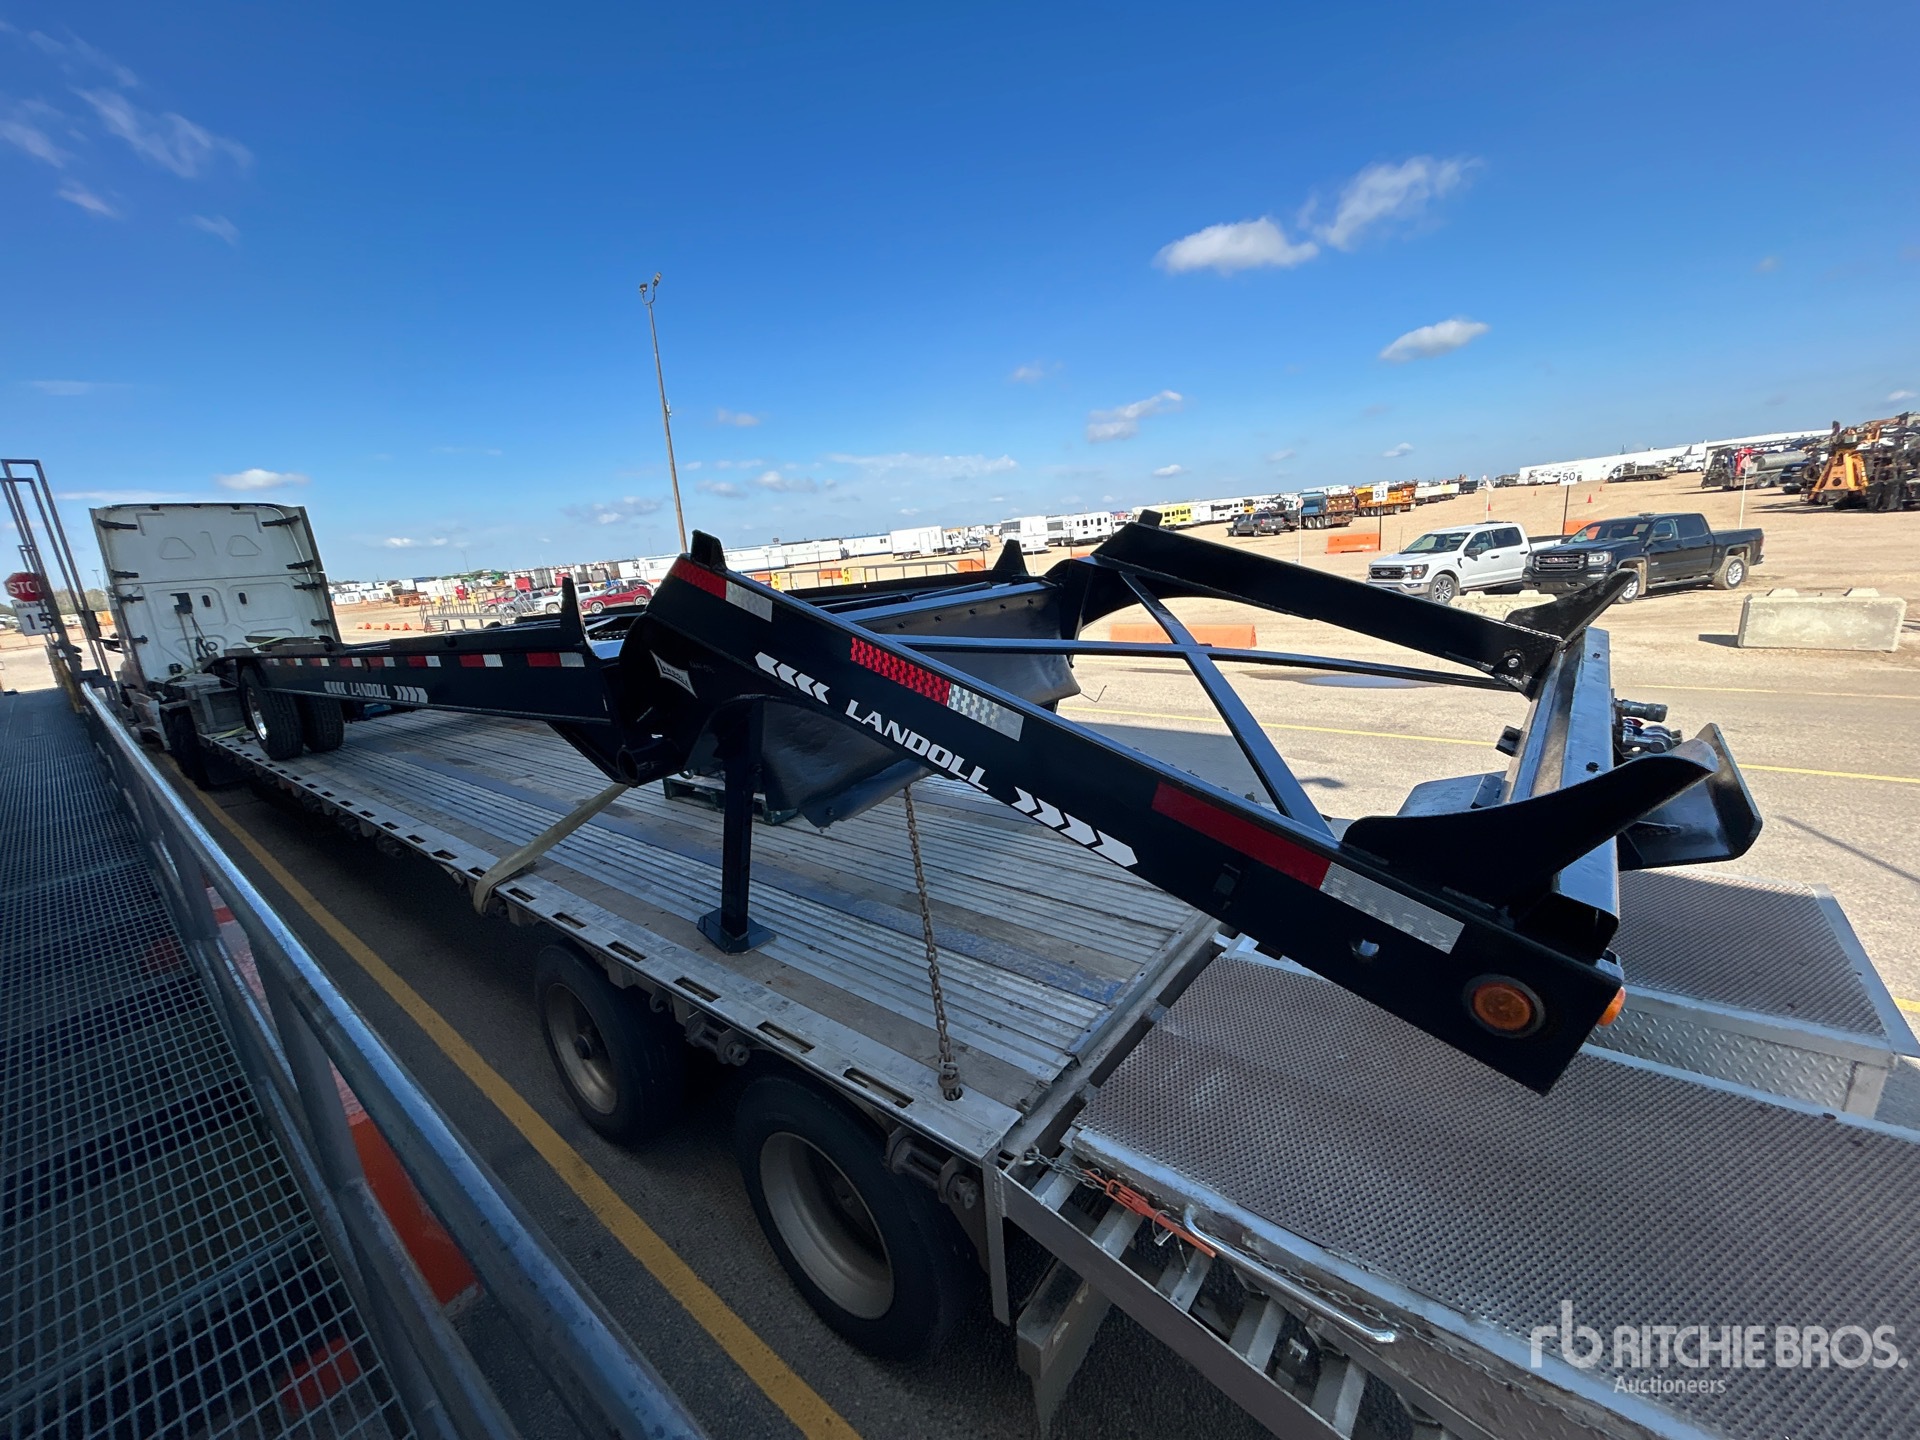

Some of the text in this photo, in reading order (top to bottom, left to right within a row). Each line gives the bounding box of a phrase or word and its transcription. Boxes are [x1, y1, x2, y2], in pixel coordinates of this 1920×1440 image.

[1562, 472, 1576, 481] 50
[1375, 490, 1386, 498] 51
[8, 581, 42, 595] STO
[26, 613, 55, 630] 15
[349, 682, 391, 699] LANDOLL
[845, 699, 989, 791] LANDOLL
